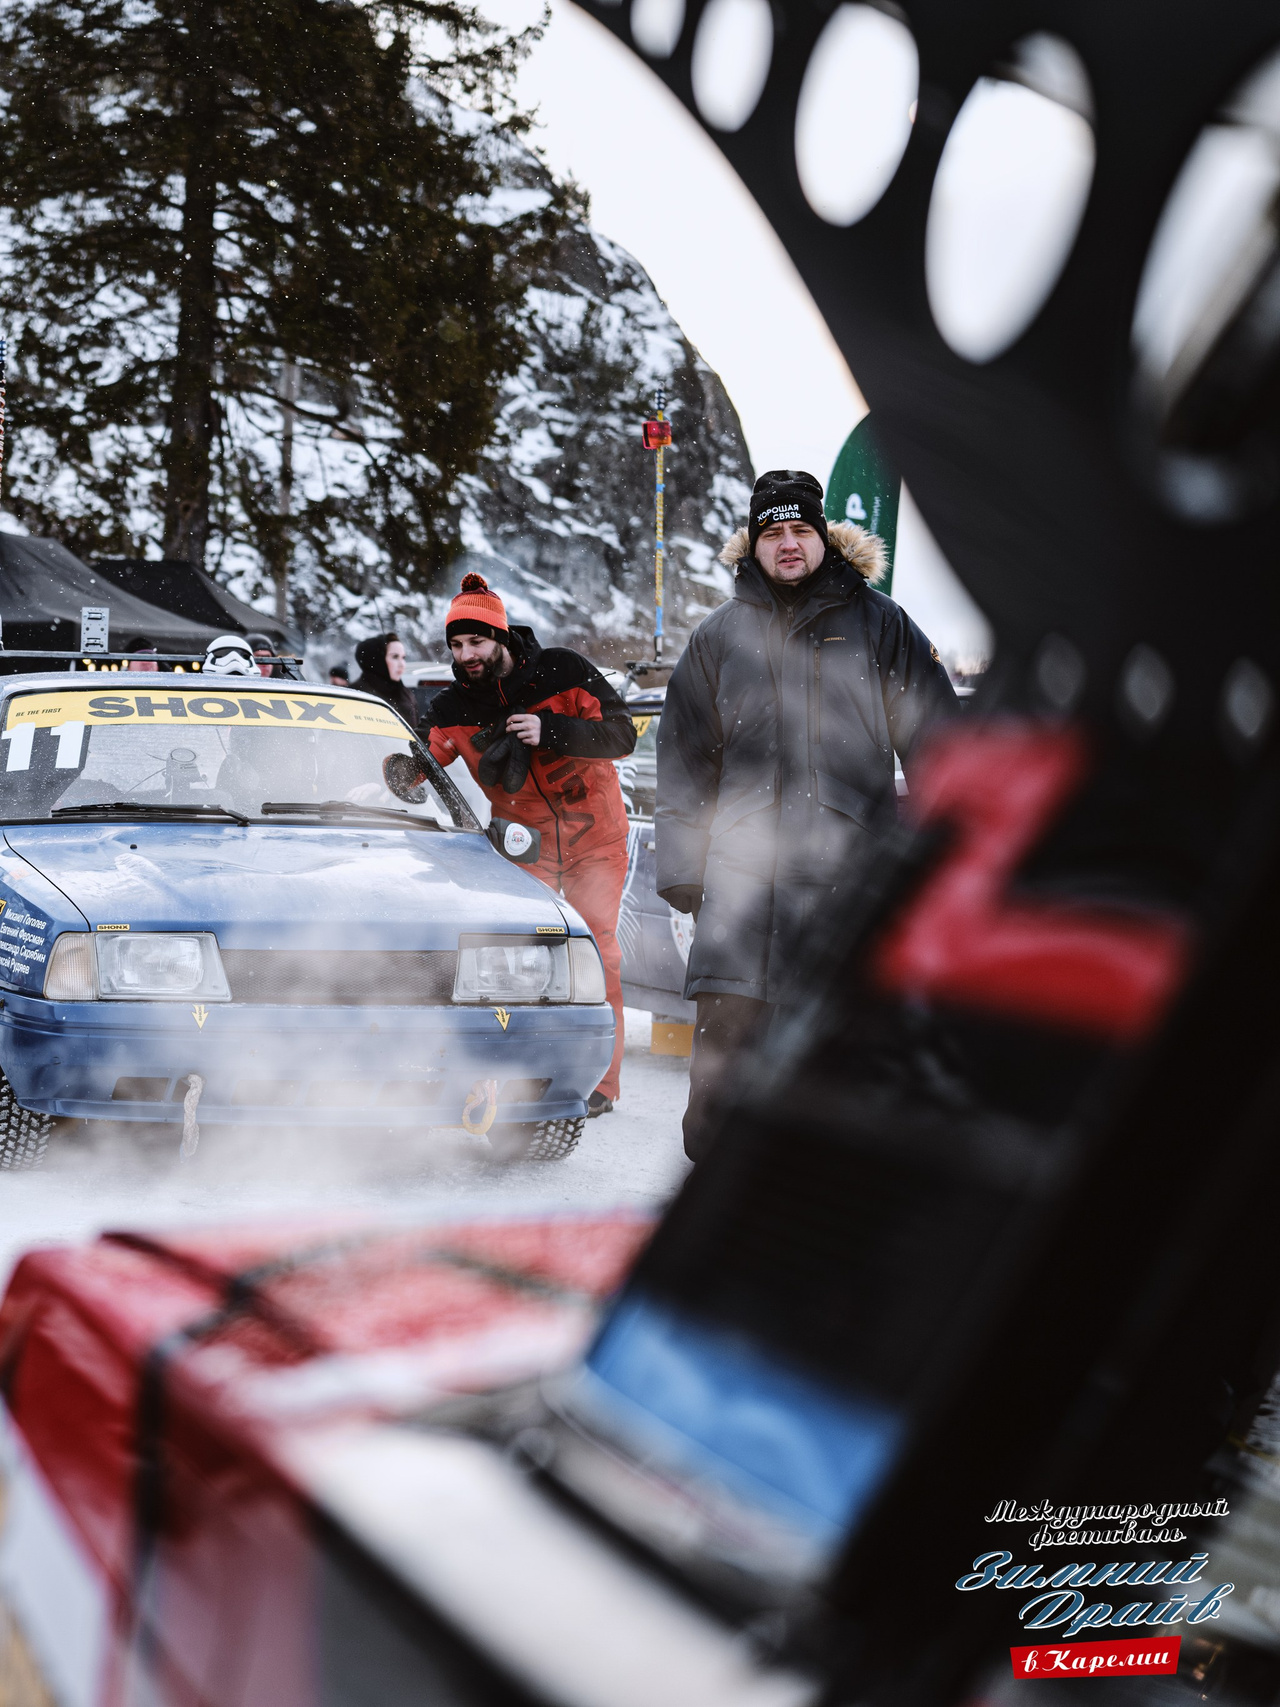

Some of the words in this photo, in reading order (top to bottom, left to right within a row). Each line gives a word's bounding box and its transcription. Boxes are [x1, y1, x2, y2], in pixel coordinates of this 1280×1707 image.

[756, 503, 799, 522] ХОРОШАЯ
[772, 510, 802, 522] СВЯЗЬ
[41, 707, 63, 715] FIRST
[88, 696, 347, 725] SHONX
[1, 720, 86, 772] 11
[4, 908, 24, 923] Михаил
[22, 913, 47, 930] Гоголев
[0, 922, 20, 938] Евгений
[18, 928, 45, 946] Ферсман
[19, 944, 47, 963] Скрябин
